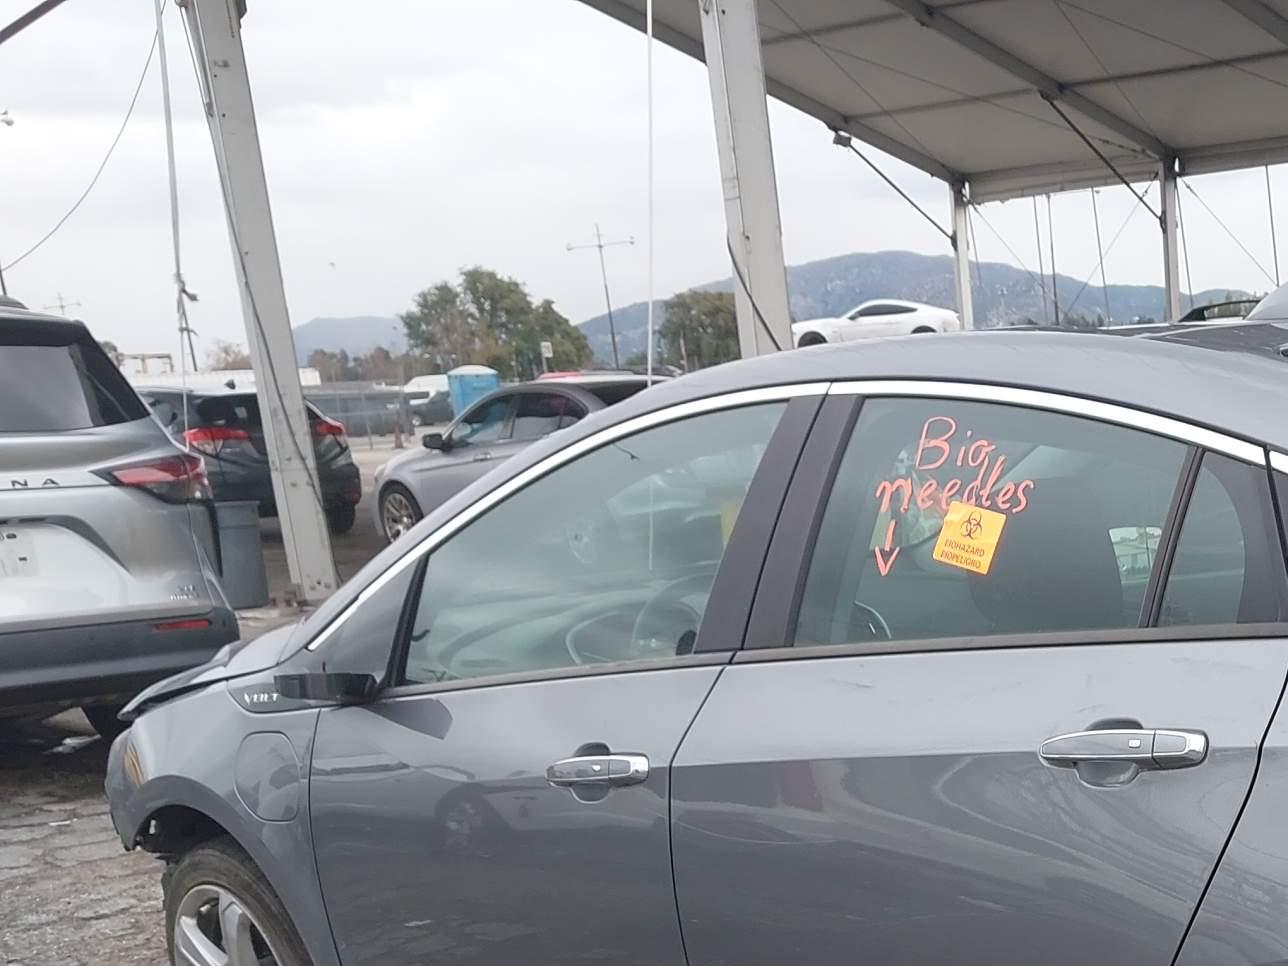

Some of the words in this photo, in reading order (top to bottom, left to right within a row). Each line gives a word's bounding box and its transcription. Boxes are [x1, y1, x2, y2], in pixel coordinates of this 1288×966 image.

[875, 454, 1034, 513] needles
[944, 538, 985, 558] BIOHAZARD
[940, 549, 982, 569] BIOPELIGRO
